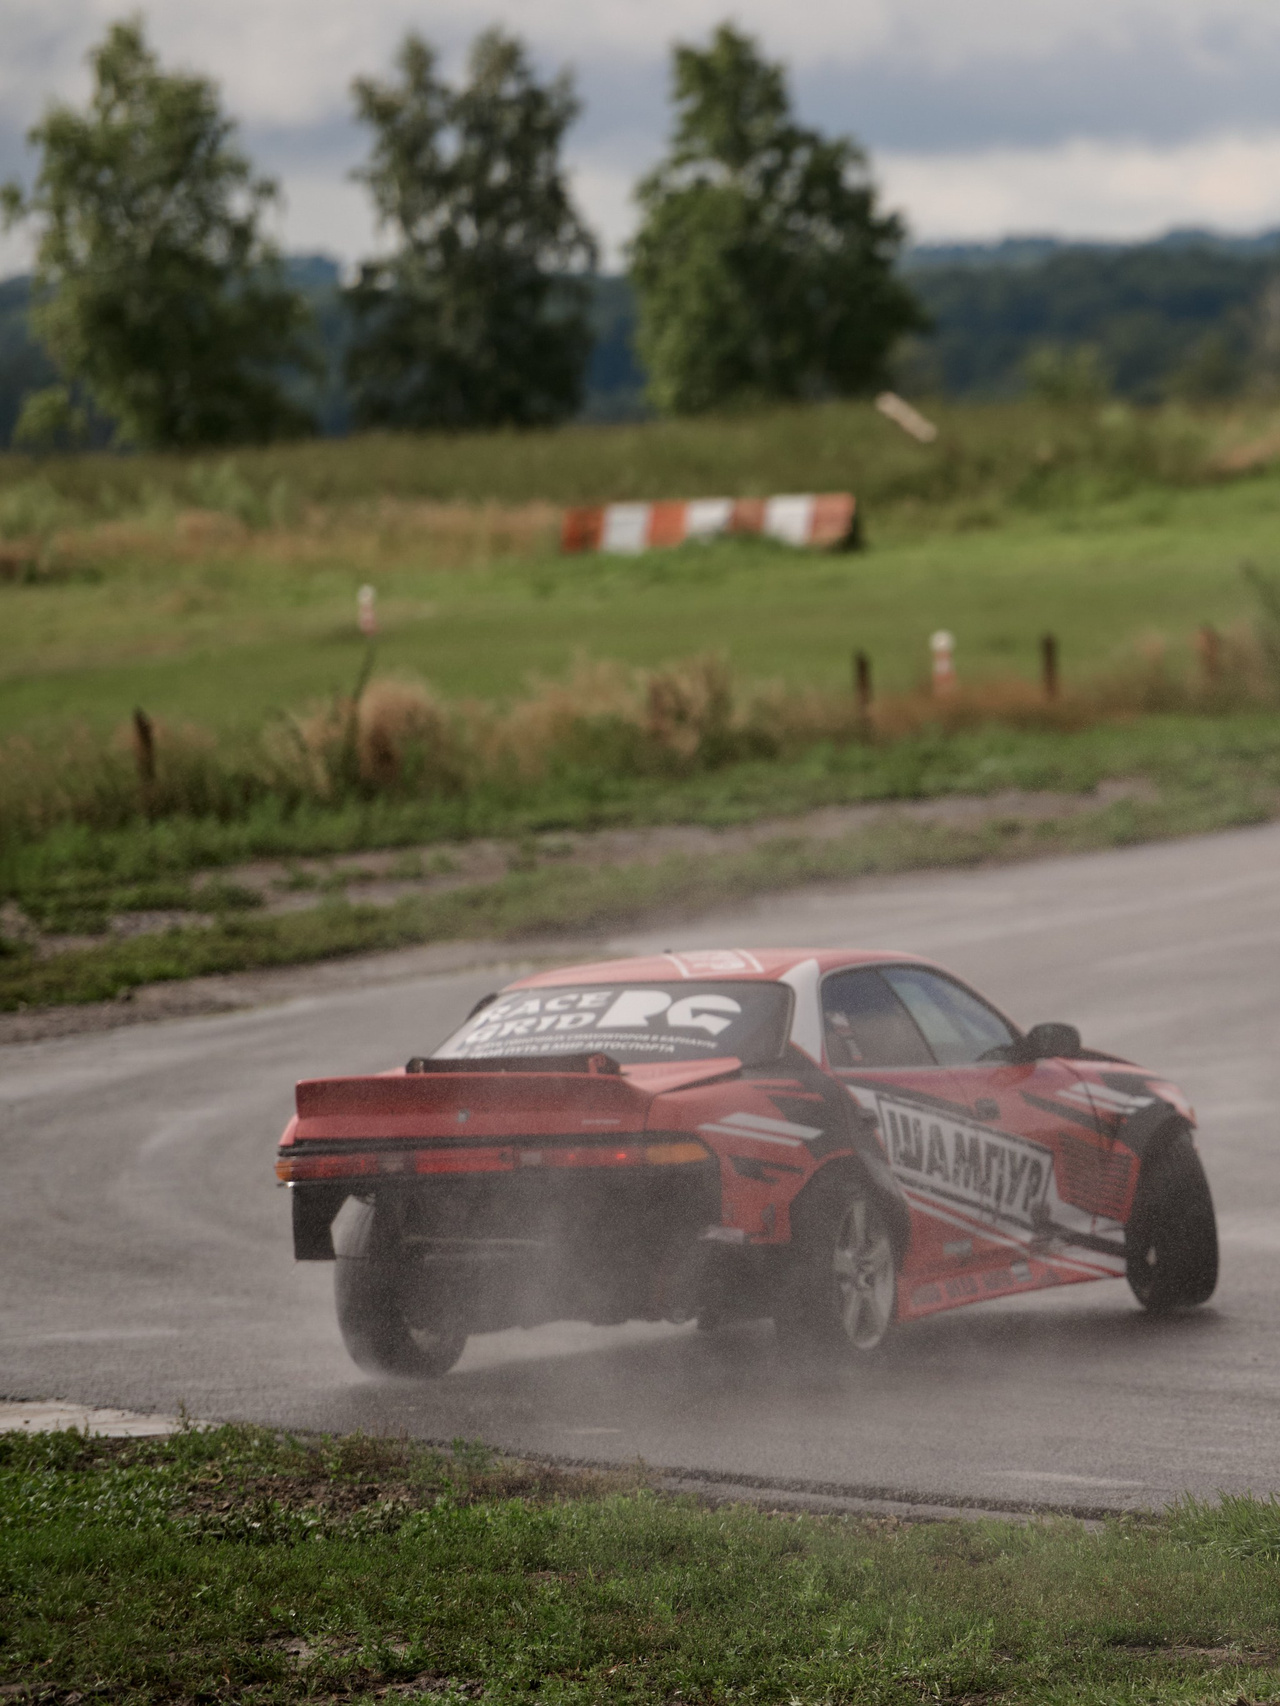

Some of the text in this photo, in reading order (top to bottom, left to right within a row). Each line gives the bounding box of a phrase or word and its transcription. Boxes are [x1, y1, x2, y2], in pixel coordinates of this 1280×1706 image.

[465, 1012, 597, 1044] GRID
[474, 991, 613, 1028] RACE
[596, 990, 742, 1035] RG
[540, 1043, 552, 1053] В
[551, 1041, 585, 1053] МИР
[583, 1041, 676, 1053] АВТОСПОРТА
[886, 1109, 1042, 1212] ШАМПУР
